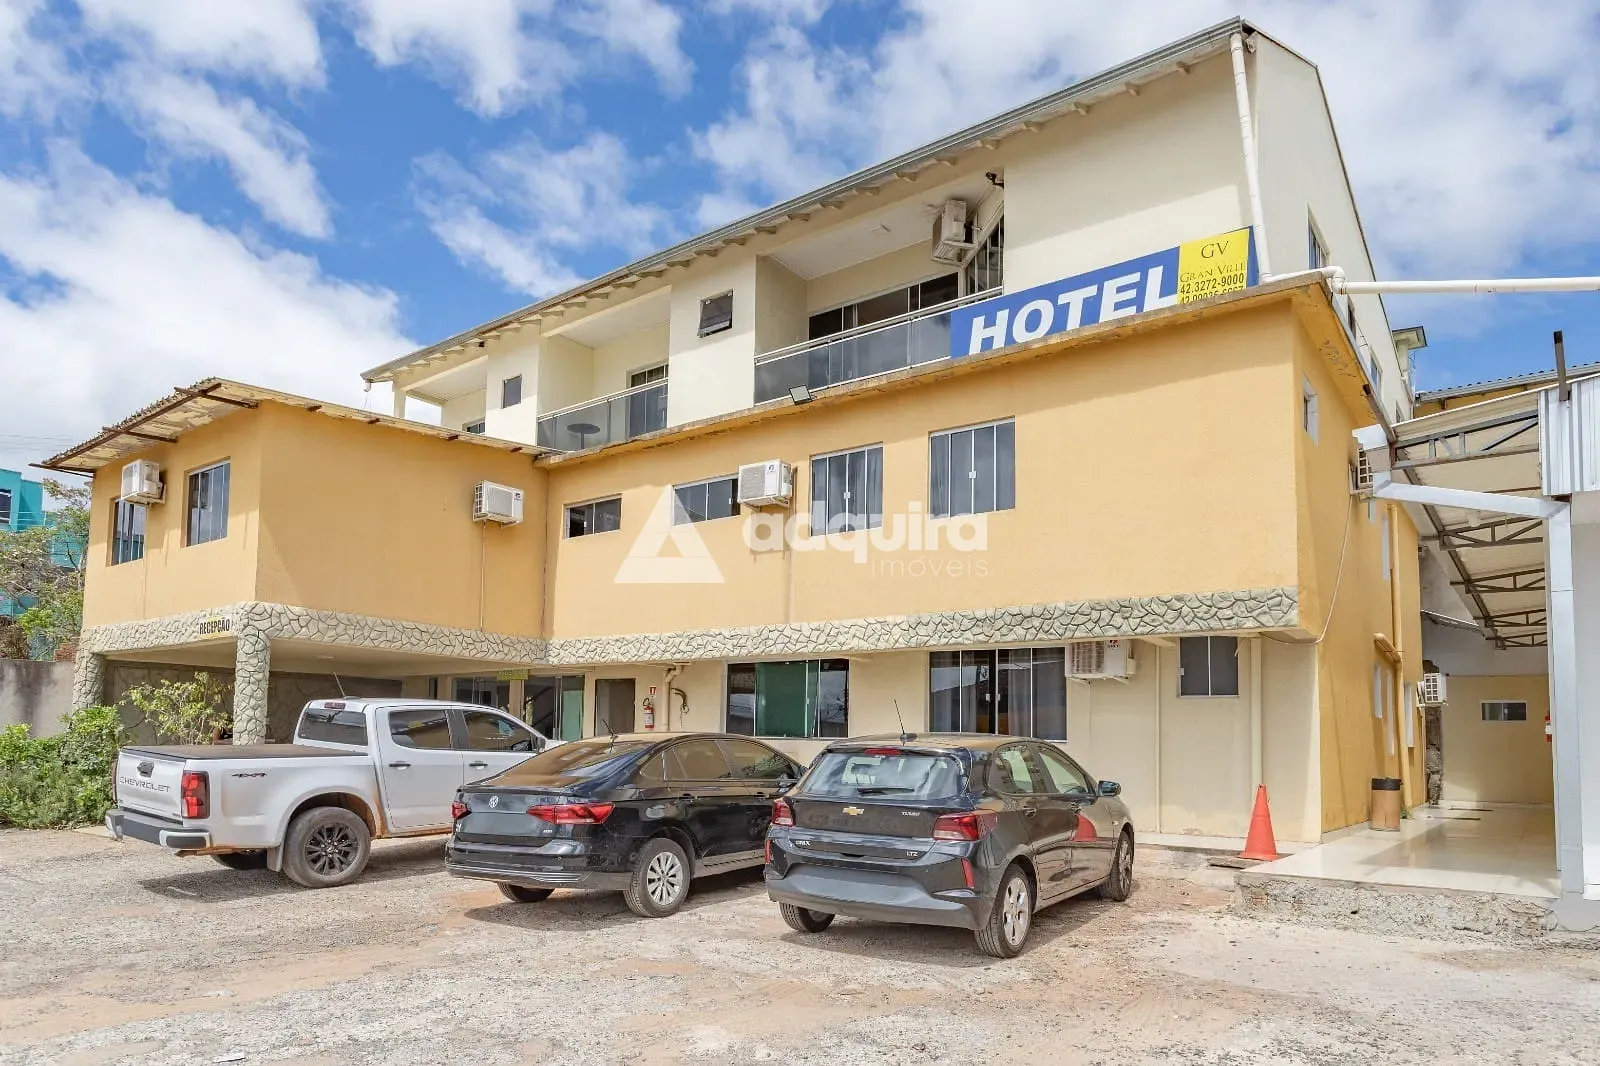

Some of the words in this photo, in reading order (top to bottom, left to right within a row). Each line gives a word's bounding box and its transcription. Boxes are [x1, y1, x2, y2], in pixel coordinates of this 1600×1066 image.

[1200, 240, 1229, 259] GV
[1180, 272, 1244, 295] 42.3272-9000
[968, 265, 1178, 355] HOTEL
[119, 776, 170, 793] CHEVROLET
